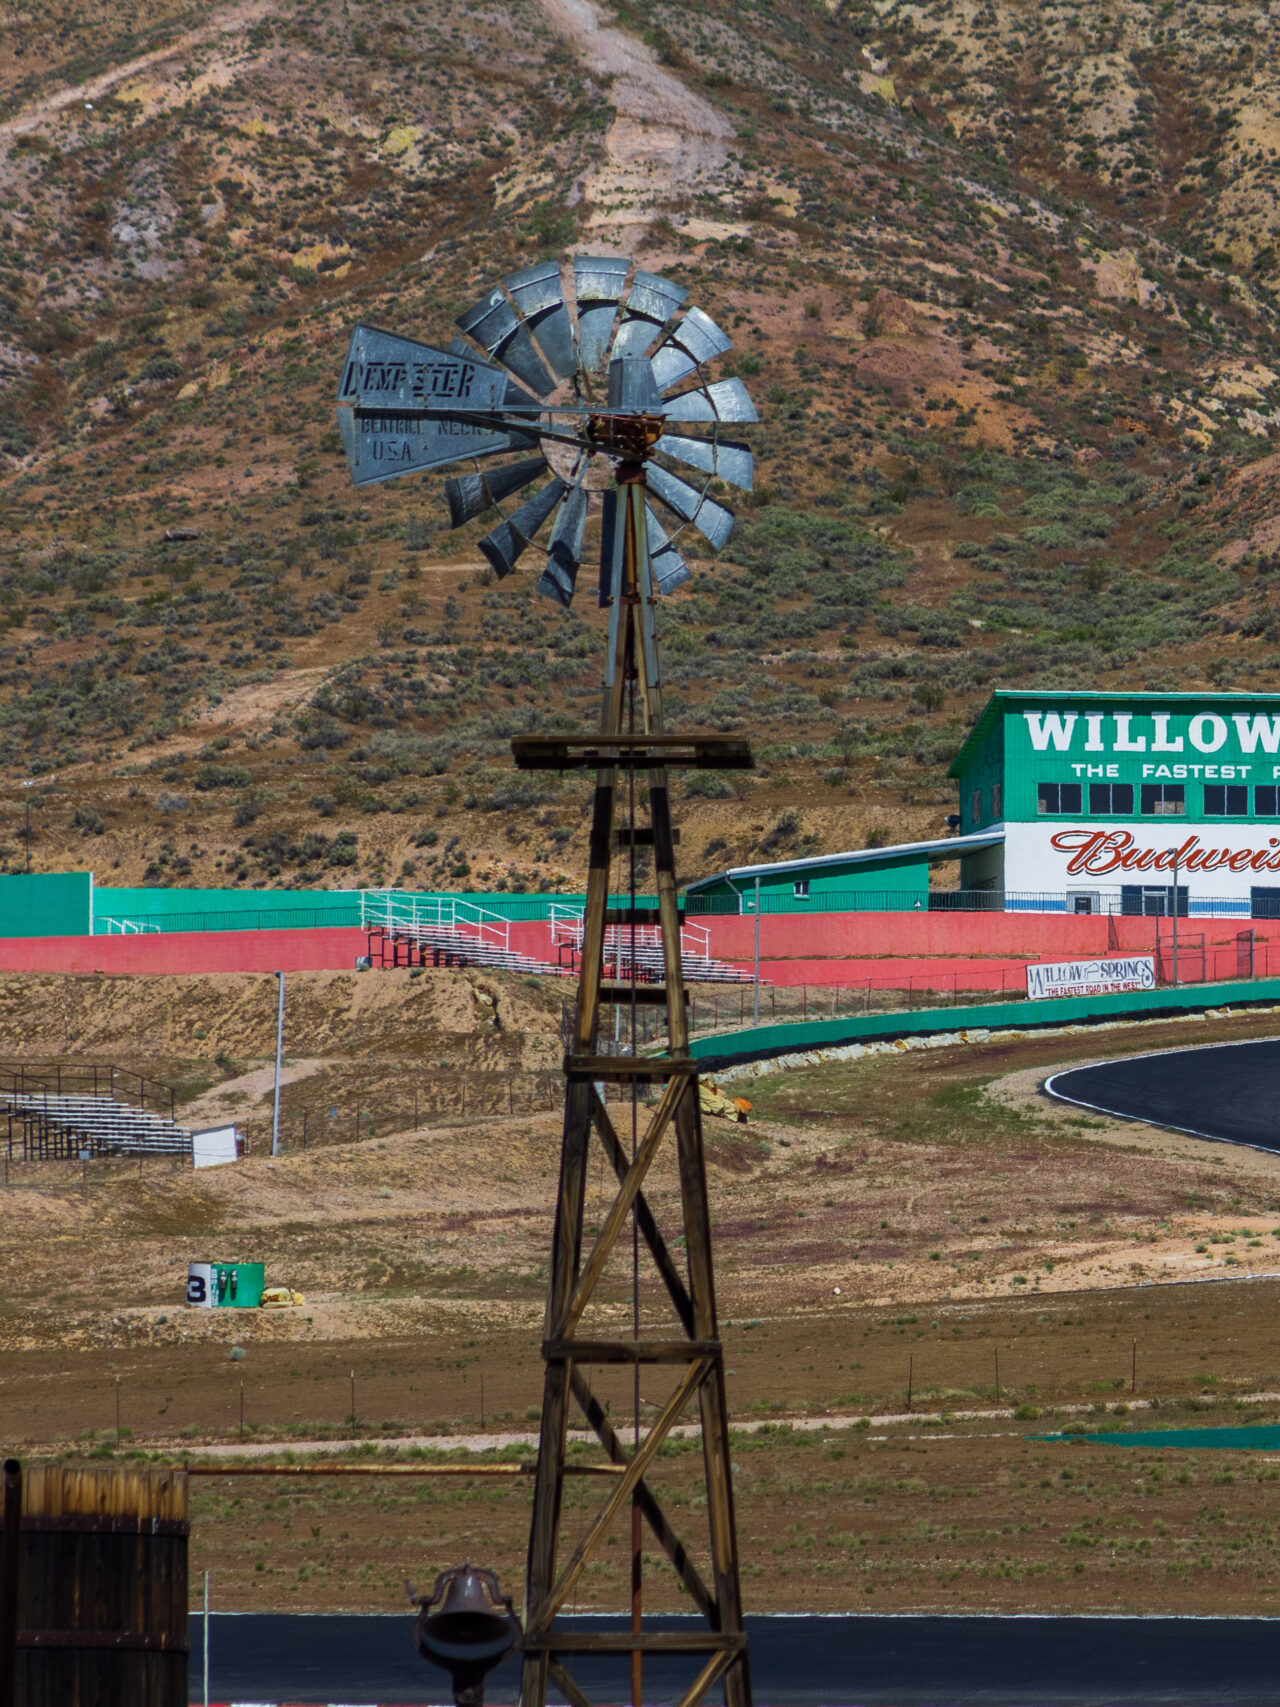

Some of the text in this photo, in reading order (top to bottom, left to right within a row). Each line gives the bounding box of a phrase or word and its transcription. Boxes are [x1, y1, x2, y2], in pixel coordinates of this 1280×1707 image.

[343, 361, 475, 397] DEMPSTER
[1072, 763, 1119, 778] THE
[1142, 764, 1252, 780] FASTEST
[1029, 960, 1154, 996] WILLOW SPRINGS
[1060, 986, 1084, 996] FASTEST
[1086, 984, 1101, 994] ROAD
[1103, 983, 1109, 993] IN
[1110, 982, 1122, 992] THE
[187, 1275, 206, 1302] 3
